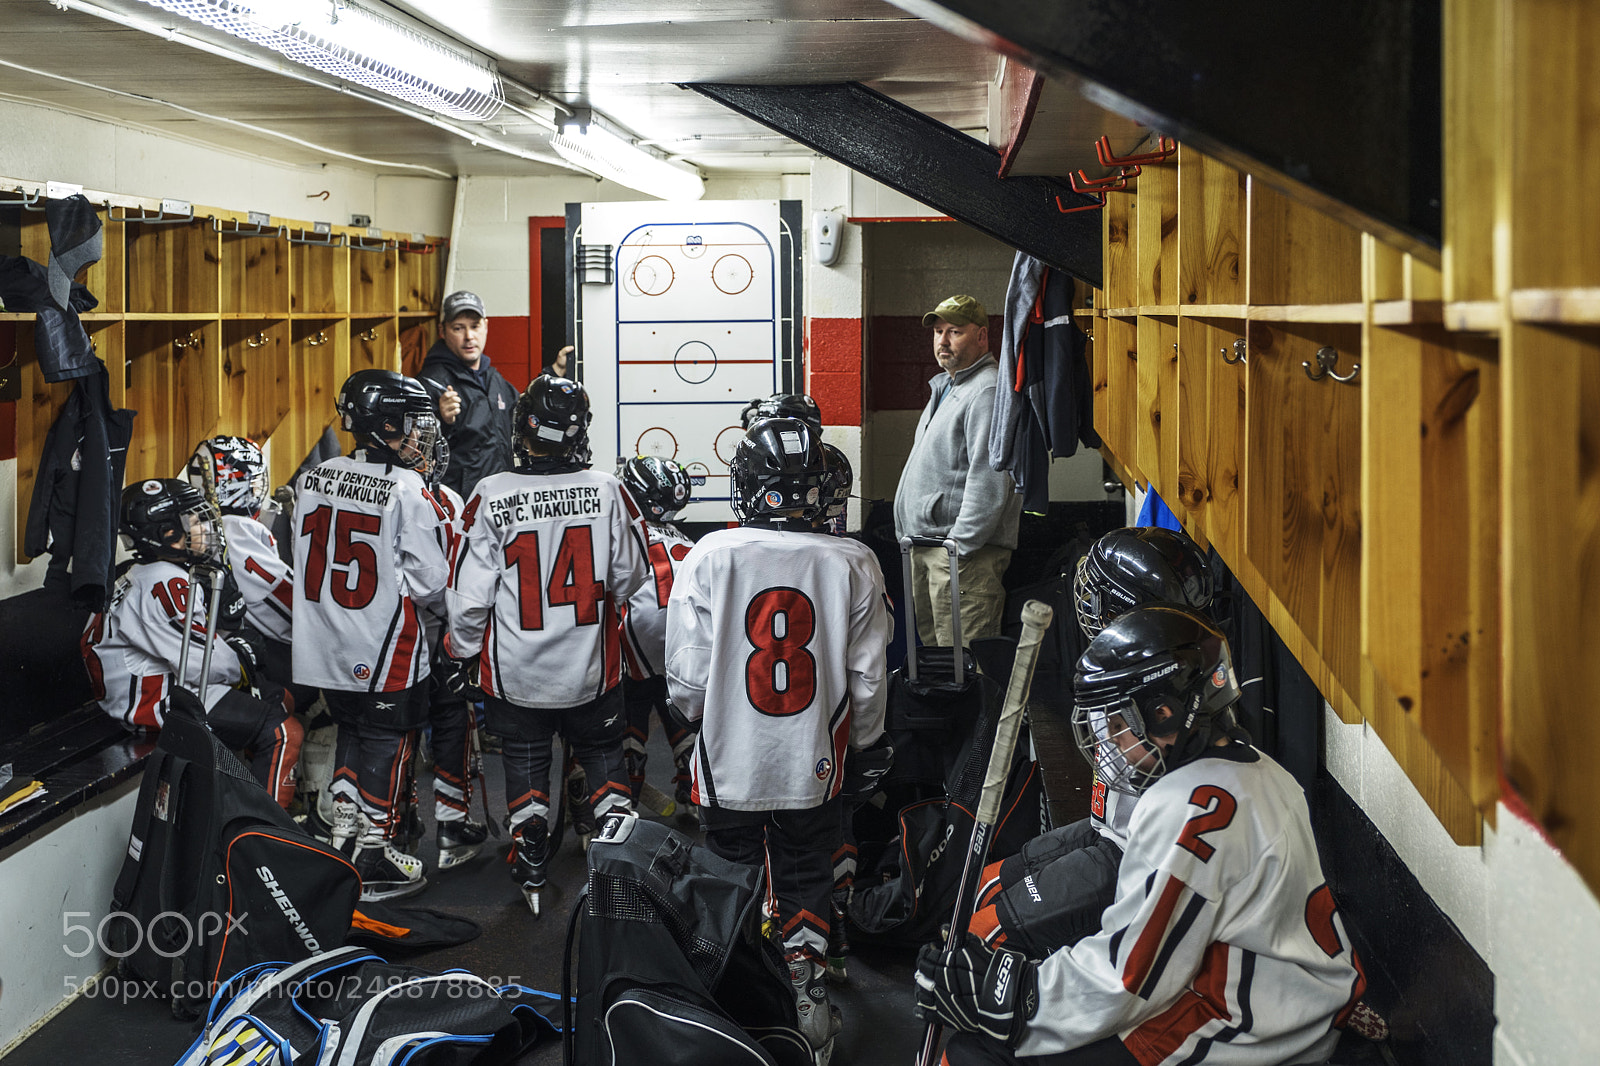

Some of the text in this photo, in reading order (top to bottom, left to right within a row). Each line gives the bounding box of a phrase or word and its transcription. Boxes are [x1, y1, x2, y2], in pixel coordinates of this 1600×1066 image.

[308, 467, 397, 491] FAMILY DENTISTRY
[324, 480, 334, 496] C.
[337, 482, 391, 507] WAKULICH
[489, 487, 599, 513] FAMILY DENTISTRY
[516, 507, 529, 522] C.
[531, 498, 601, 520] WAKULICH
[245, 556, 277, 585] 1
[300, 504, 381, 610] 15
[504, 524, 605, 631] 14
[151, 577, 190, 618] 16
[1111, 588, 1136, 606] BAUER
[744, 586, 816, 717] 8
[1143, 662, 1179, 683] BAUER
[973, 821, 988, 856] BAUE
[1175, 784, 1238, 865] 2
[255, 865, 326, 958] SHER-WO
[994, 955, 1015, 1000] CCM
